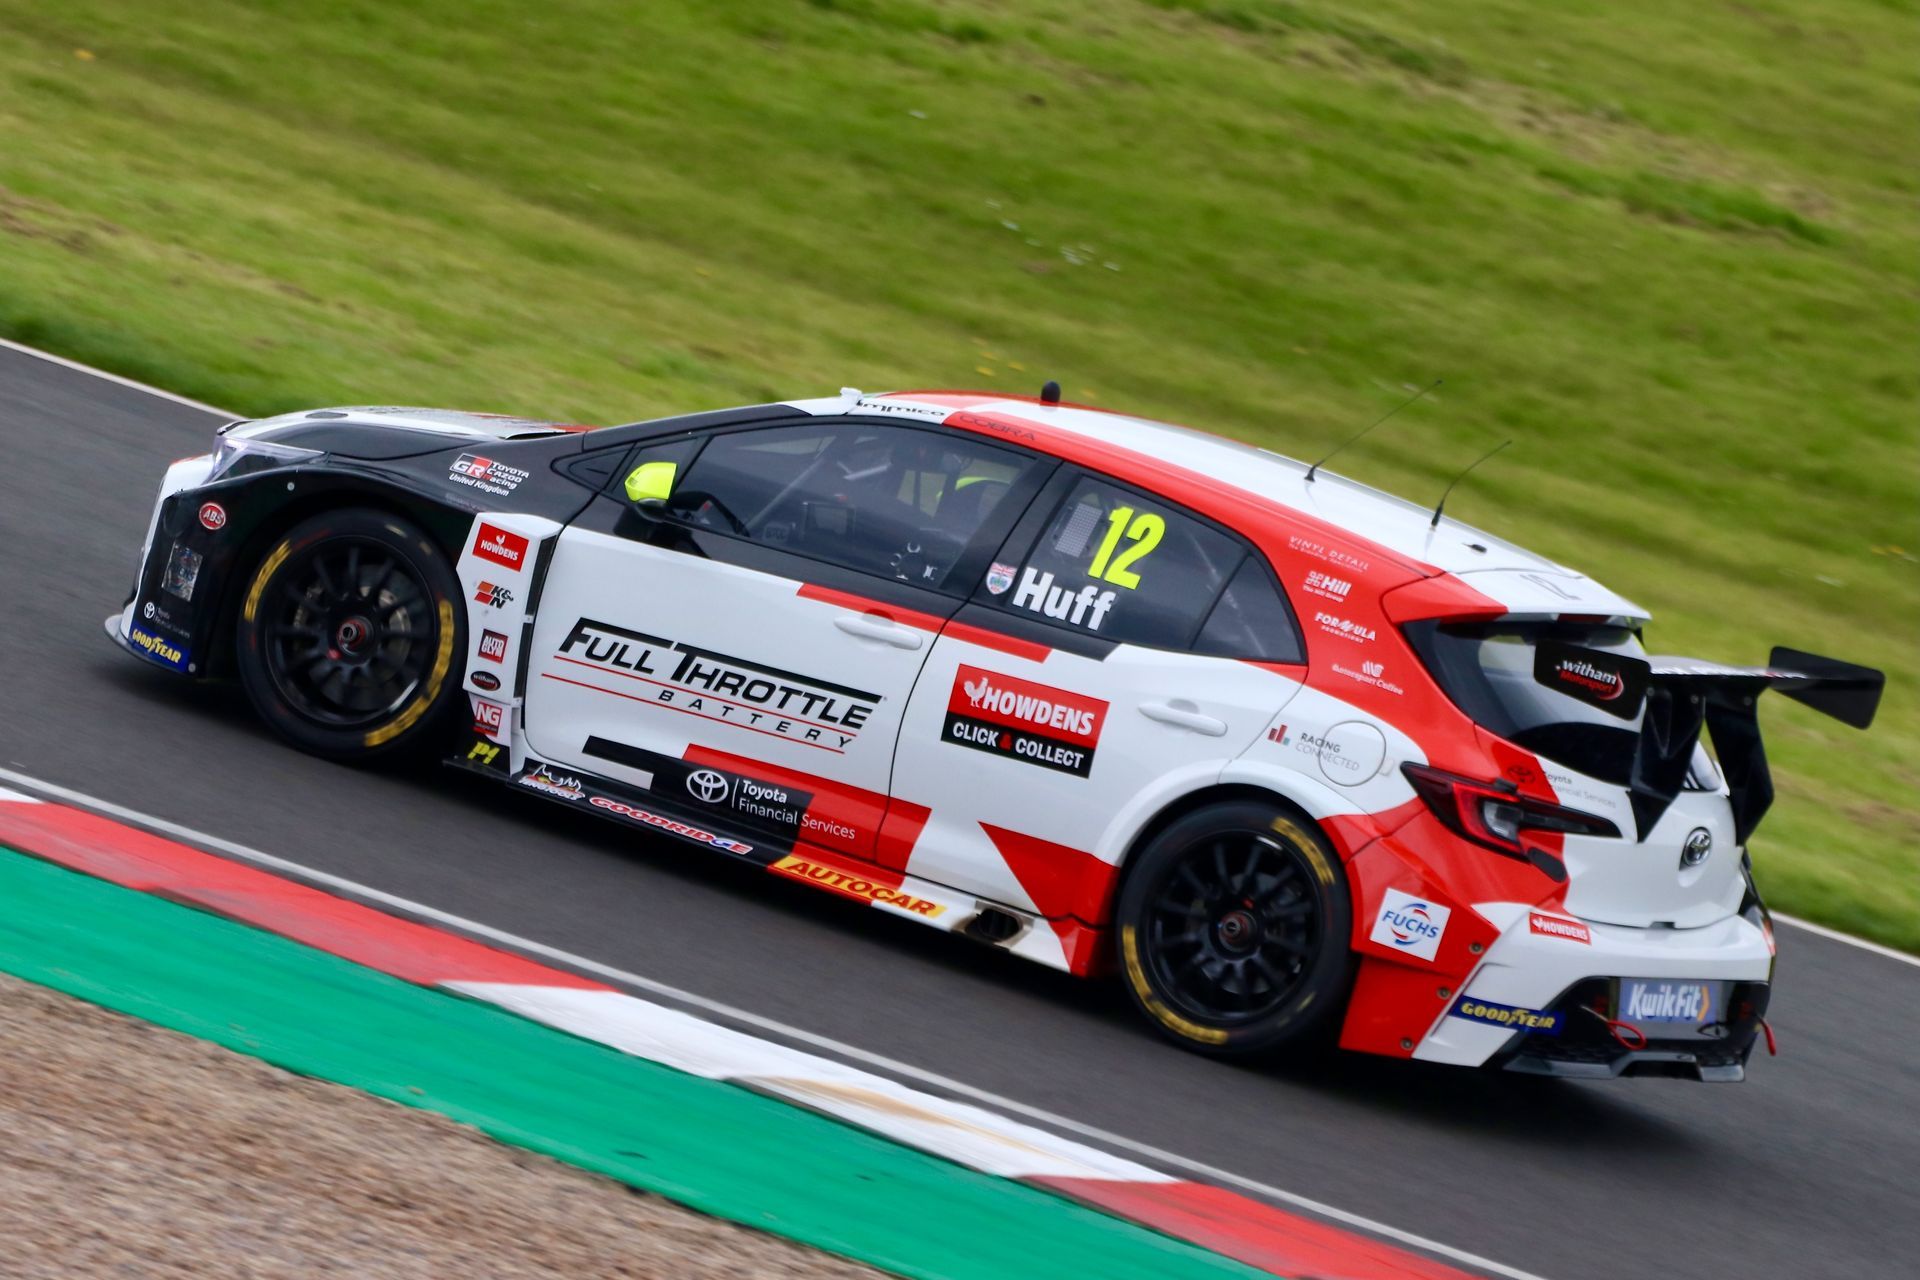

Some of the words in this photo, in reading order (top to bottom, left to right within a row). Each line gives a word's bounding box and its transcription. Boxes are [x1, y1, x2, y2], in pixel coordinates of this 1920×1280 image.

[960, 415, 1036, 441] COBRA
[453, 461, 486, 478] GR
[491, 461, 530, 478] TOYOTA
[449, 473, 474, 487] United
[474, 480, 510, 497] Kingdom
[203, 509, 223, 525] ABS
[480, 540, 519, 561] HOWDENS
[1088, 506, 1166, 590] 12
[1290, 536, 1325, 554] VINYL
[1329, 550, 1369, 570] DETAIL
[1012, 566, 1117, 631] Huff
[1321, 576, 1352, 597] Hill
[132, 628, 182, 664] GOODYEAR
[483, 635, 505, 649] AUTO
[558, 617, 674, 676] FULL
[670, 642, 883, 731] THROTTLE
[1562, 660, 1617, 685] witham
[476, 703, 501, 726] NG
[657, 689, 853, 748] BATTERY
[982, 686, 1096, 737] HOWDENS
[467, 741, 500, 765] P1
[952, 721, 999, 748] CLICK
[1015, 738, 1084, 769] COLLECT
[742, 780, 788, 805] Toyota
[589, 797, 753, 855] GOODRIDGE
[738, 797, 798, 826] Financial
[800, 814, 856, 840] Services
[786, 861, 937, 915] AUTOCAR
[1381, 910, 1439, 938] FUCHS
[1543, 920, 1588, 941] HOWDENS
[1459, 1001, 1556, 1030] GOODYEAR
